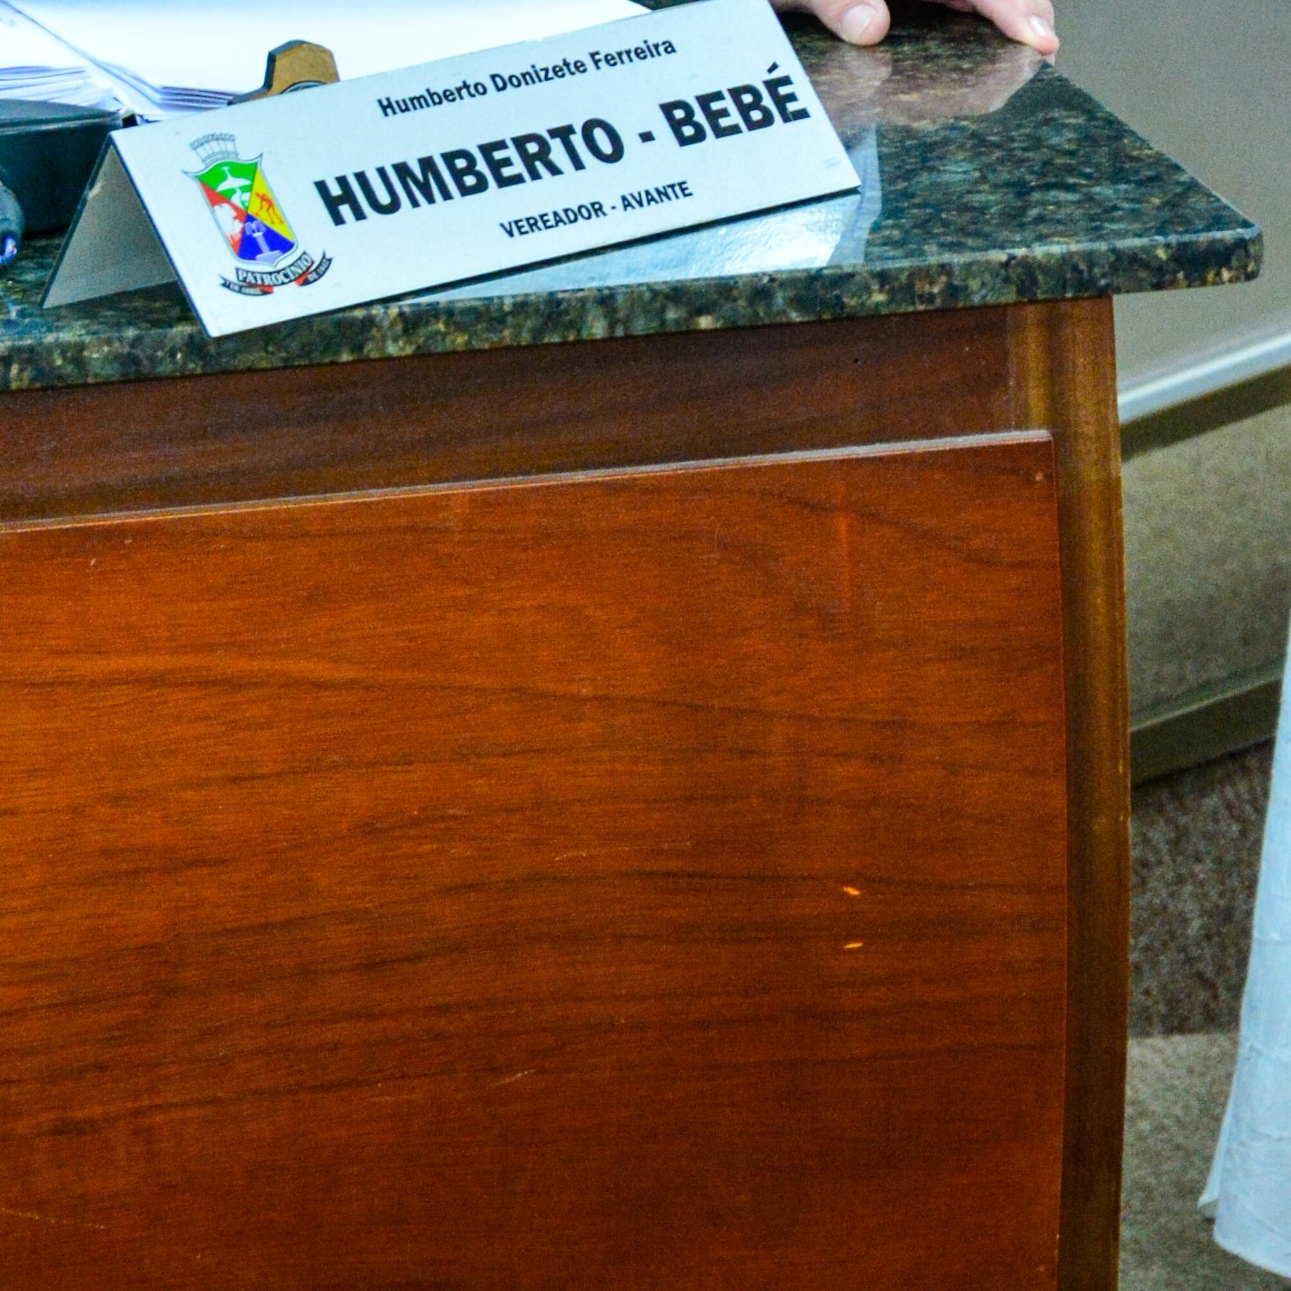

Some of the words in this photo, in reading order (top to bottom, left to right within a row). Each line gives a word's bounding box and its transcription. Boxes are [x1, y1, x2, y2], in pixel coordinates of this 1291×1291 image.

[377, 79, 488, 117] Humberto
[490, 59, 588, 93] Donizete
[589, 39, 677, 70] Ferreira
[314, 118, 625, 227] HUMBERTO
[638, 130, 656, 144] -
[659, 61, 811, 148] BEBÉ
[499, 202, 608, 238] VEREADOR
[621, 180, 694, 212] AVANTE
[237, 252, 314, 287] PATROCÍNIO
